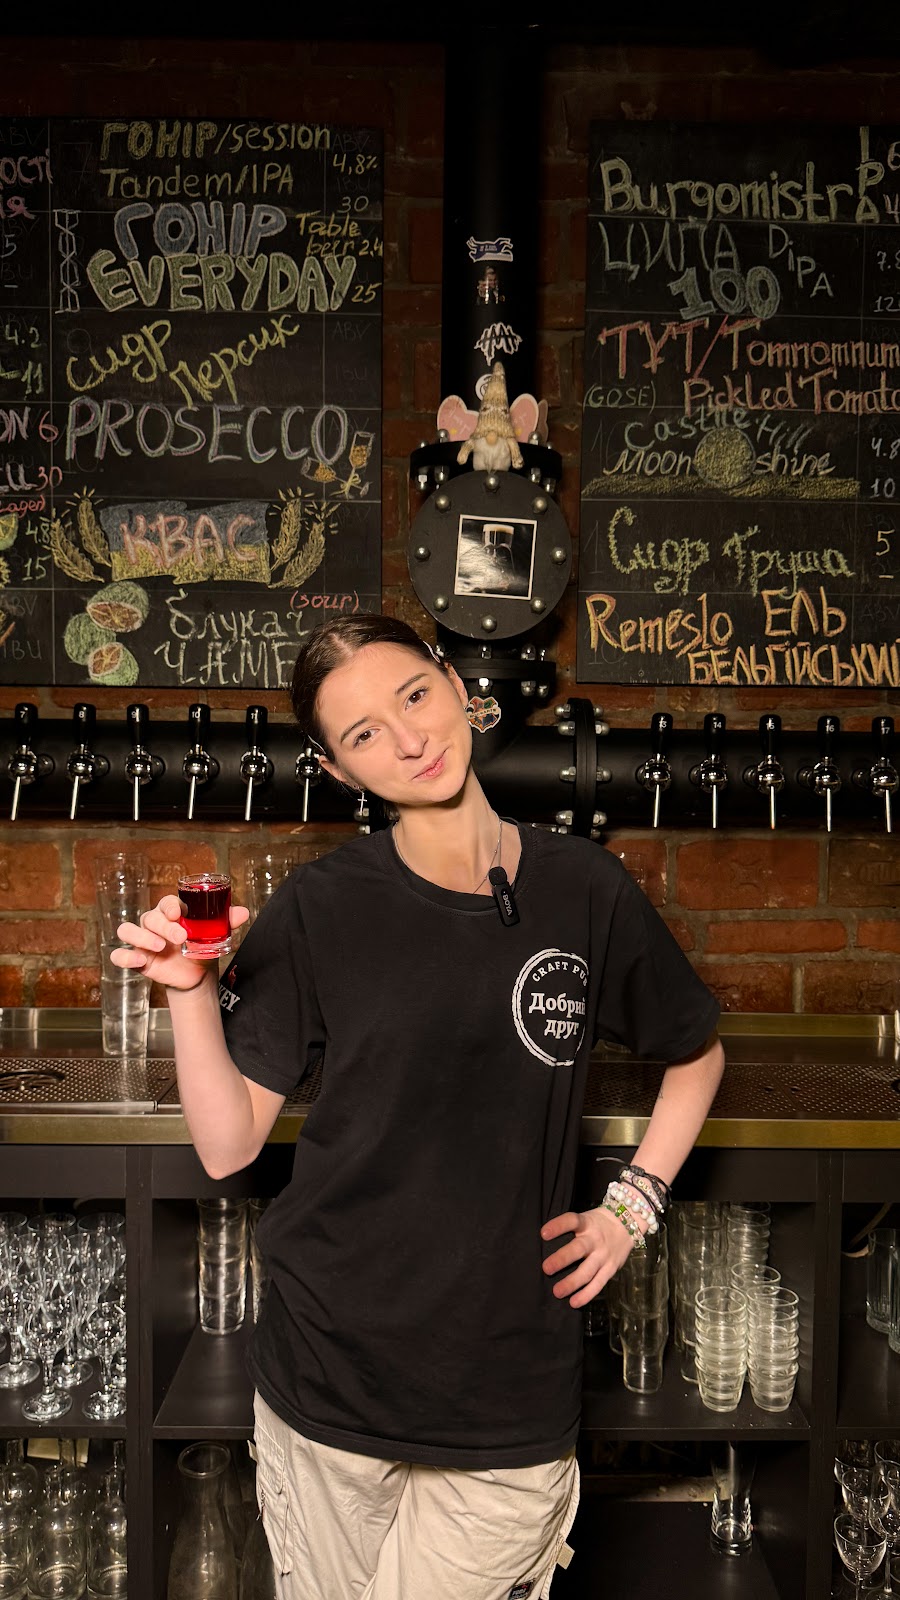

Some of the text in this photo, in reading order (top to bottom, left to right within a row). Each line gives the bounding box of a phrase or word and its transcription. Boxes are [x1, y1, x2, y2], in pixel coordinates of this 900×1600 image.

[332, 153, 378, 175] 4,8%
[600, 156, 853, 223] Burgomistr
[337, 195, 369, 213] 30
[113, 201, 287, 260] ГОНІР
[295, 210, 362, 237] Table
[86, 249, 357, 313] EVERYDAY
[351, 283, 382, 304] 25
[667, 266, 781, 321] 100
[5, 324, 43, 348] 4.2
[65, 396, 349, 466] PROSECCO
[870, 476, 896, 499] 10
[875, 529, 895, 556] 5
[22, 555, 51, 581] 15
[585, 593, 734, 659] Remeslo
[713, 721, 722, 729] 14
[502, 894, 513, 916] BOYA
[532, 961, 569, 982] CRAFT
[544, 1019, 579, 1040] друг
